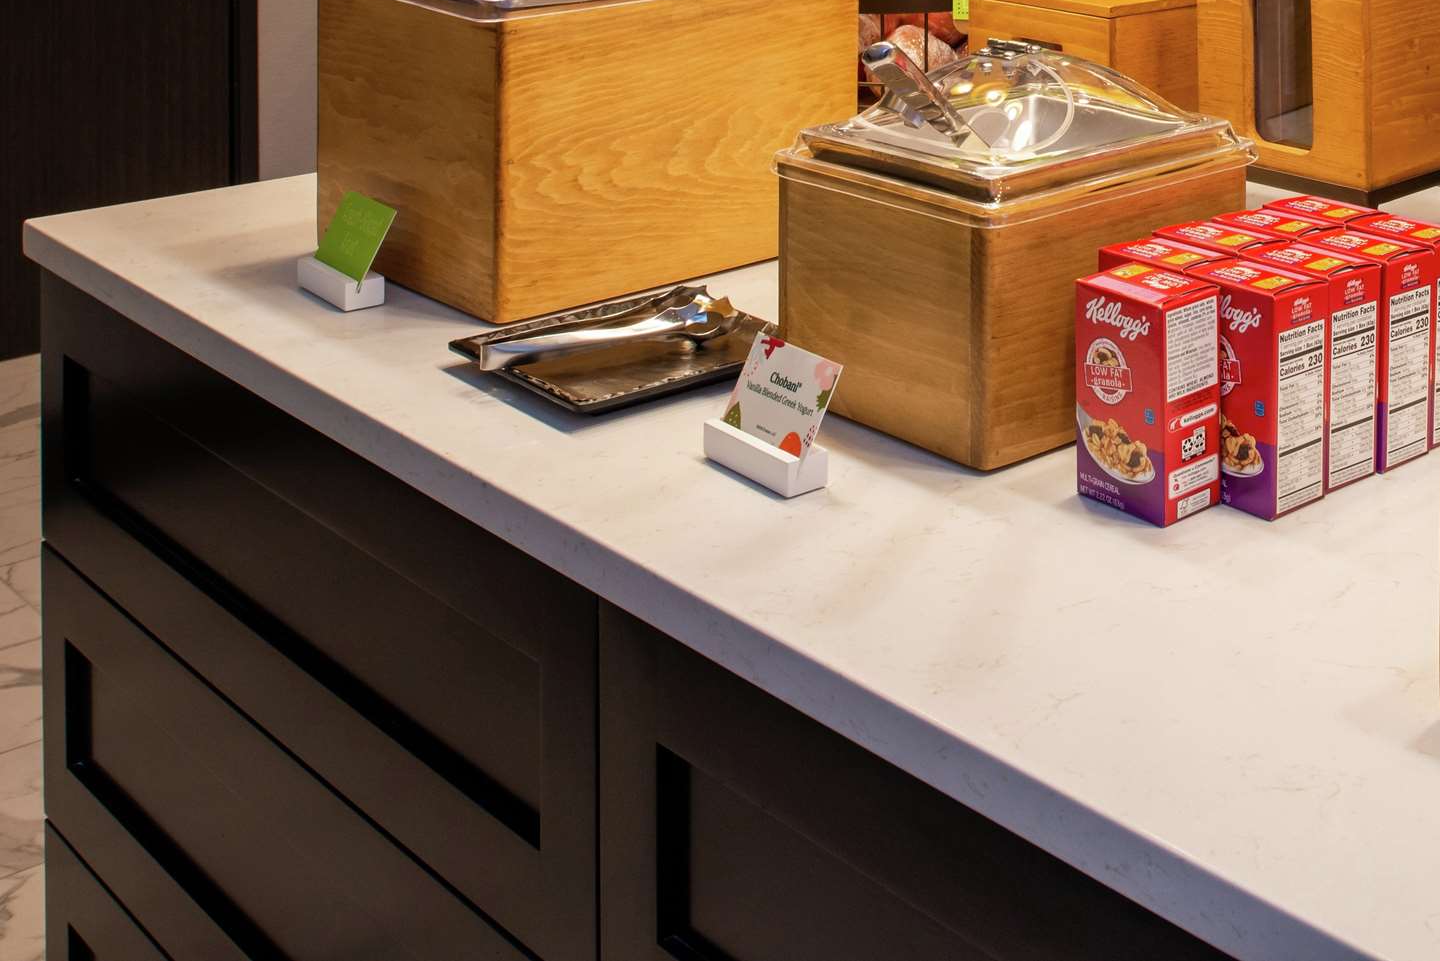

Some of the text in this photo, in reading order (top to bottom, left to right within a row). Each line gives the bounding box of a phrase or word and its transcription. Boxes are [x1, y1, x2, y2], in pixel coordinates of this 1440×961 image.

[1391, 289, 1429, 306] Nutrition Facts
[1086, 296, 1151, 341] Kellogg's
[1221, 294, 1262, 333] logg's
[1333, 304, 1375, 323] Nutrition Facts
[1279, 323, 1323, 343] Nutrition Facts
[1390, 316, 1429, 338] Calories 230
[1333, 333, 1375, 355] Calories 230
[1090, 366, 1123, 378] LOW FAT
[1280, 353, 1323, 377] Calories 230
[1093, 377, 1122, 388] granola
[747, 380, 814, 417] Vanilla Blended Greek Yogurt
